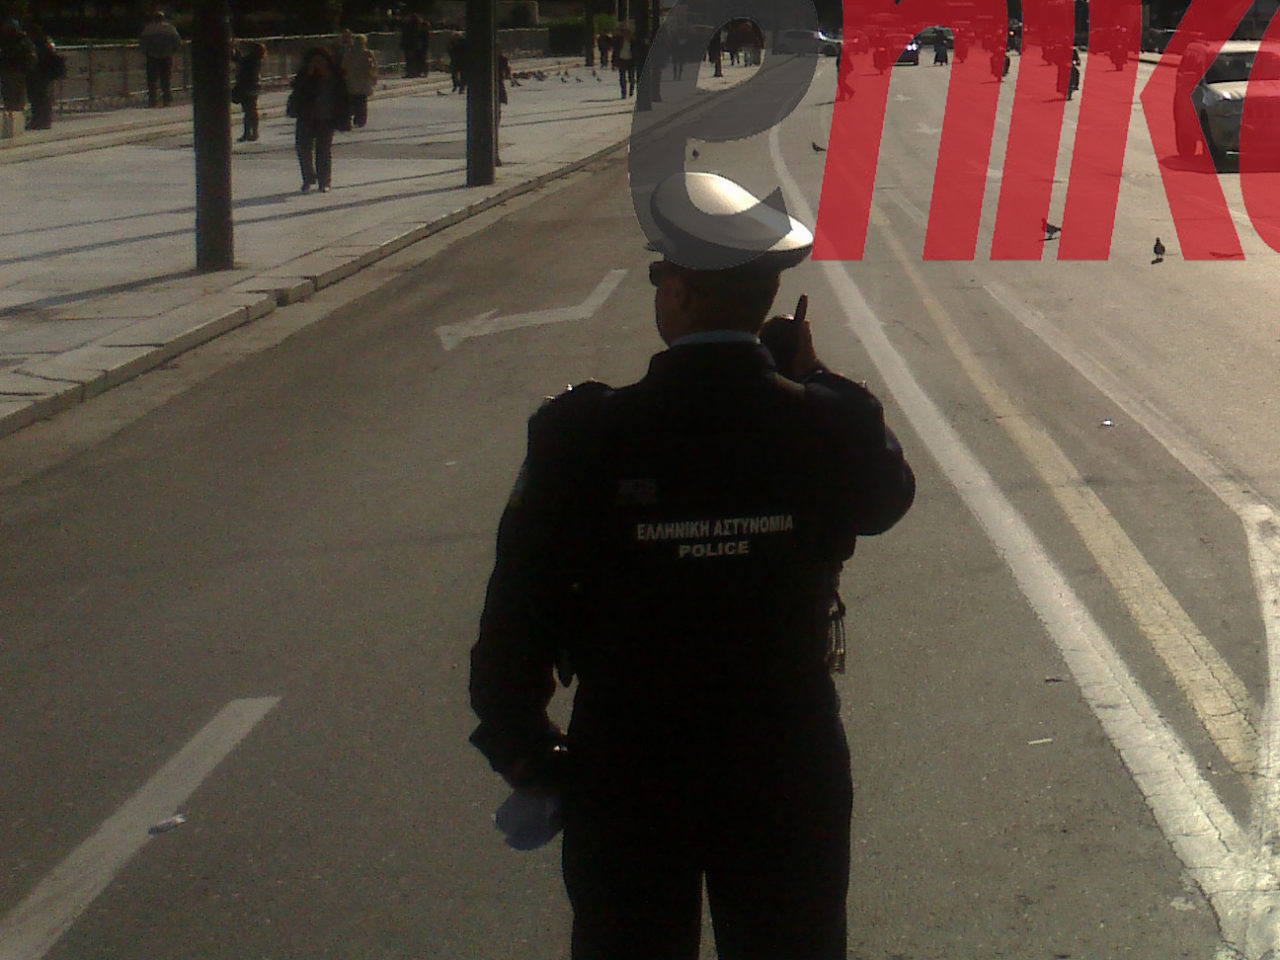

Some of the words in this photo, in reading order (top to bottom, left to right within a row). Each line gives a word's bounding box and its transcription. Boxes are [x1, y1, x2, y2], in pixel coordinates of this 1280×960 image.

[637, 520, 710, 540] ΕΛΛΗΝΙΚΗ
[714, 515, 794, 537] ΑΣΤΥΝΟΜΙΑ
[678, 541, 749, 558] POLICE
